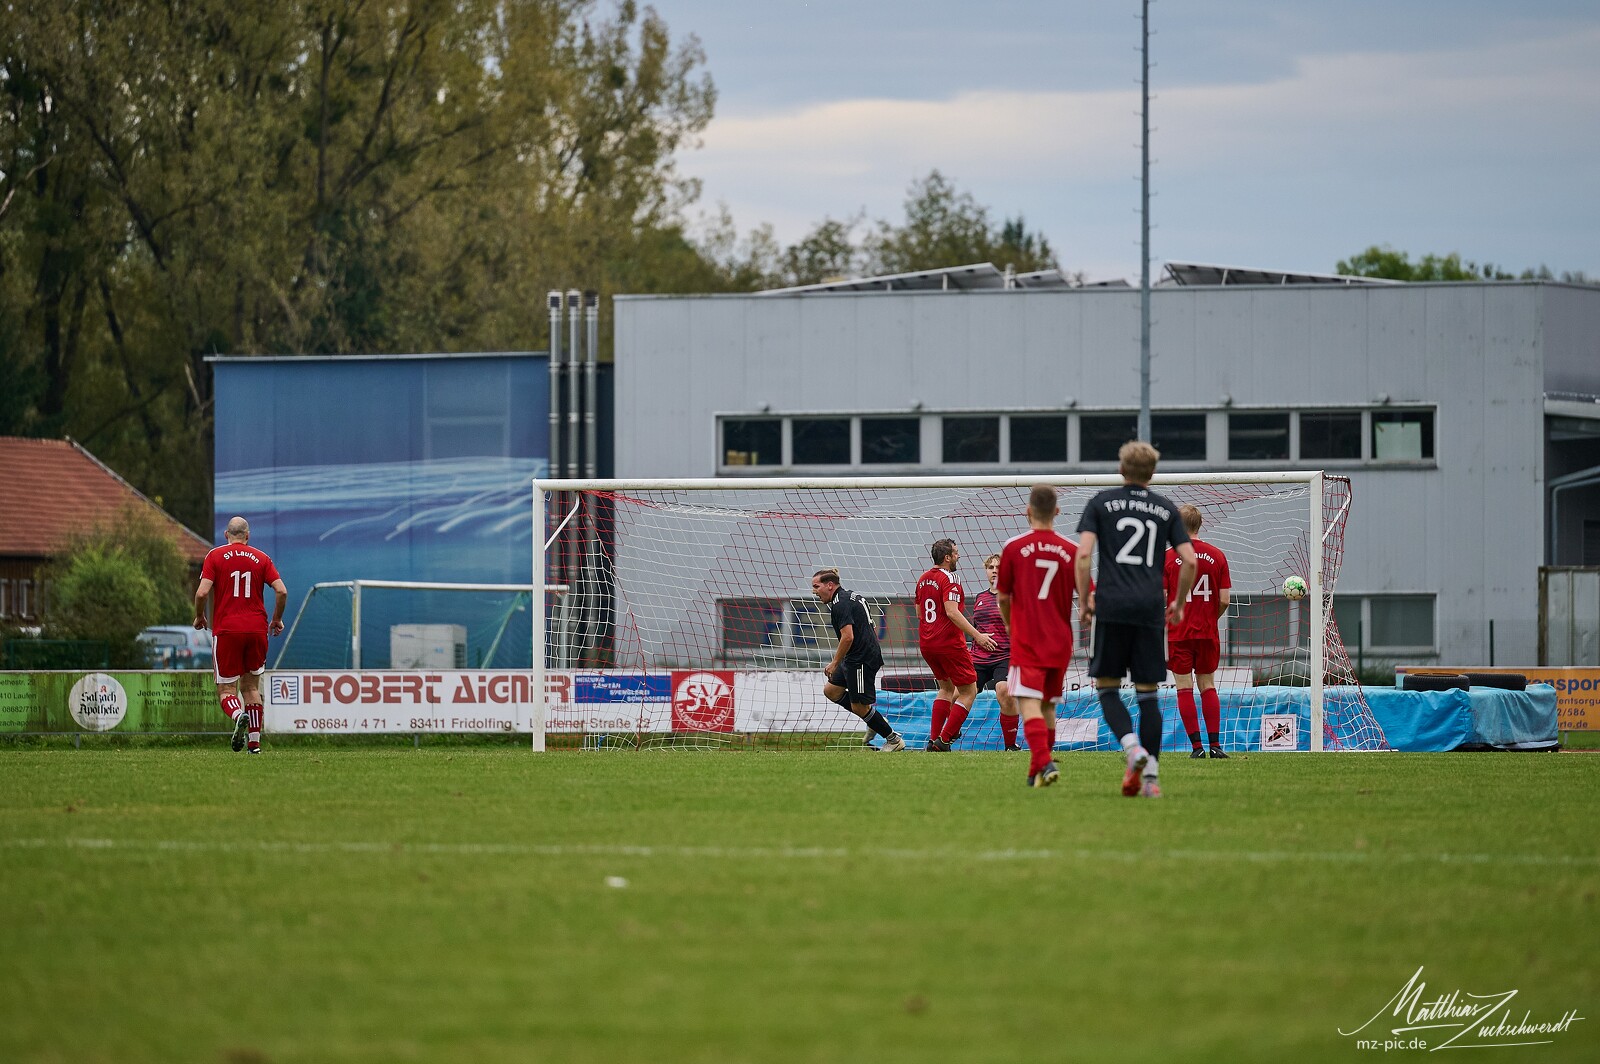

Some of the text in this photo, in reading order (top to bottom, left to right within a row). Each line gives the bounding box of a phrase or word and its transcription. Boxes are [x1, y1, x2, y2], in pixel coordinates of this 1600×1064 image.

[1104, 499, 1171, 521] TSV PALLING
[1020, 541, 1072, 563] SV Laufen
[1116, 516, 1158, 567] 21
[223, 550, 260, 564] SV Laufen
[1175, 552, 1215, 565] S aufen
[230, 570, 252, 598] 11
[1035, 558, 1059, 600] 7
[924, 598, 937, 623] 8
[162, 690, 176, 698] Tag
[303, 675, 442, 704] ROBERT
[687, 684, 722, 711] SV
[77, 704, 120, 716] Apotheke
[173, 698, 217, 706] Gesundheit
[311, 718, 348, 729] 08684
[373, 718, 387, 729] 71
[410, 718, 445, 729] 83411
[452, 718, 512, 731] Fridolfing
[529, 718, 585, 728] Lufener
[590, 718, 631, 729] Straße
